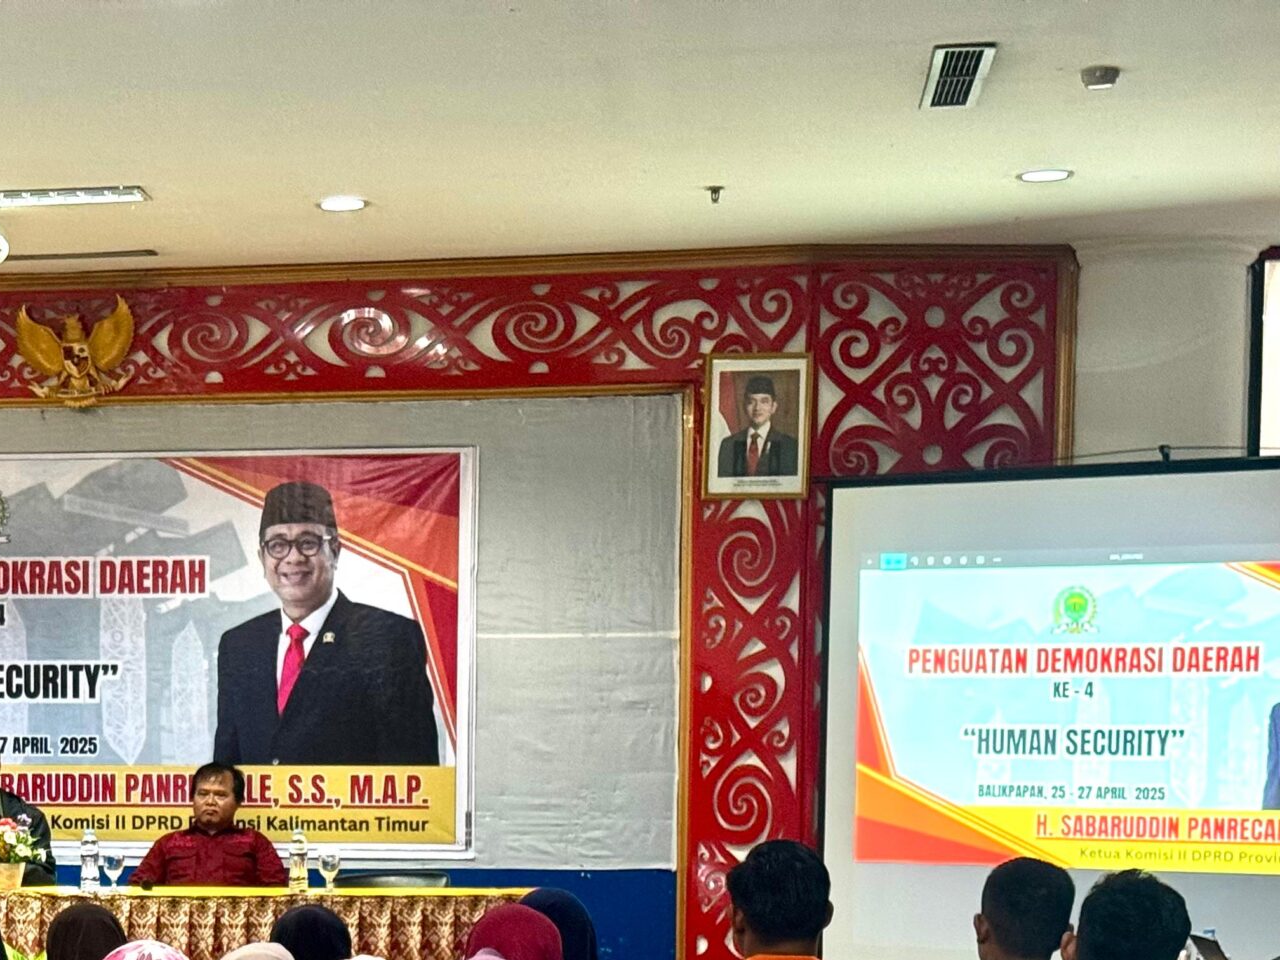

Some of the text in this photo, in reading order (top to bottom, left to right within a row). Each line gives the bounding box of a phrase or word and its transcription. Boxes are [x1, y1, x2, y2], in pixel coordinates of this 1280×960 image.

[99, 559, 207, 595] DAERAH
[908, 645, 1261, 674] PENGUATAN DEMOKRASI DAERAH
[1053, 682, 1070, 698] KE
[1084, 681, 1094, 698] 4
[12, 736, 51, 754] APRIL
[60, 737, 98, 755] 2025
[0, 773, 116, 802] BARUDDIN
[125, 773, 279, 807] PANRLE,
[288, 774, 340, 807] S.S.,
[350, 774, 429, 804] M.A.P.
[977, 784, 1048, 800] BALIKPAPAN,
[1051, 785, 1066, 799] 25
[1077, 786, 1092, 800] 27
[1096, 786, 1127, 800] APRIL
[1135, 787, 1166, 801] 2025
[50, 813, 110, 830] Komisi
[115, 814, 126, 830] II
[132, 814, 183, 830] DPRD
[267, 815, 370, 832] Kalimantan
[374, 815, 429, 832] Timur
[1036, 814, 1280, 841] H. SABARUDDIN PANRECA
[1080, 847, 1120, 860] Ketua
[1126, 847, 1173, 861] Komisi
[1192, 850, 1234, 862] DPRD
